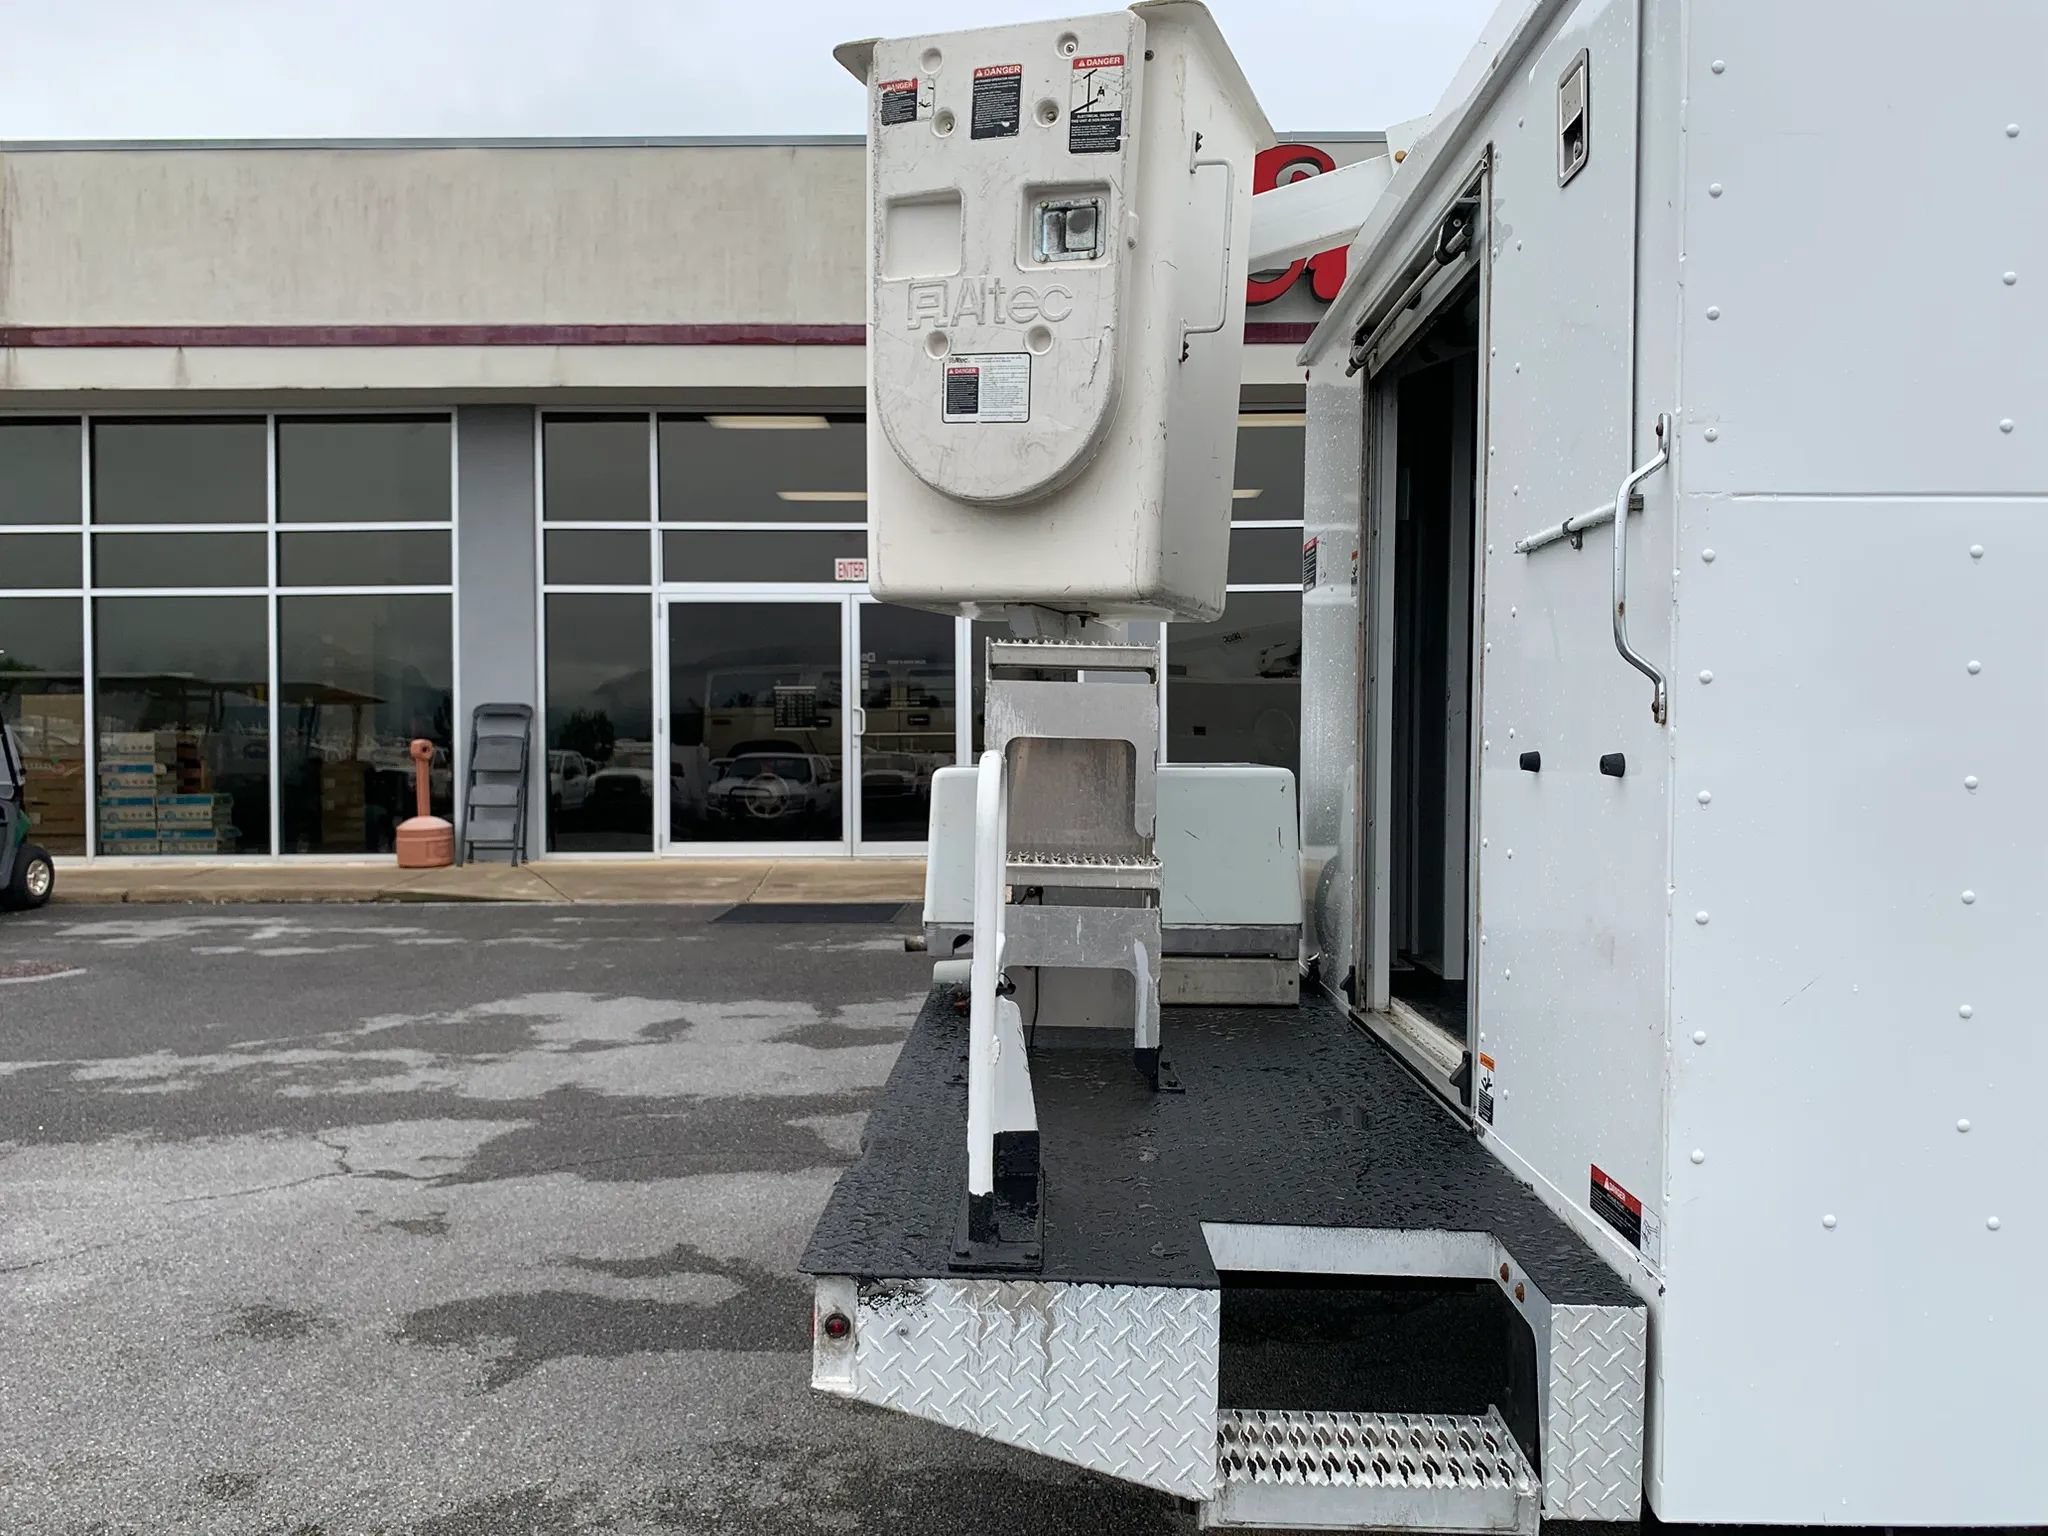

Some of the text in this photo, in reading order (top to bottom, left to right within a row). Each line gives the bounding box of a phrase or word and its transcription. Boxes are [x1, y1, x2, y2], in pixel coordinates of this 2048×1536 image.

[1086, 57, 1121, 67] DANGER
[984, 65, 1021, 75] DANGER
[951, 277, 1072, 327] Altec
[838, 562, 864, 578] ENTER
